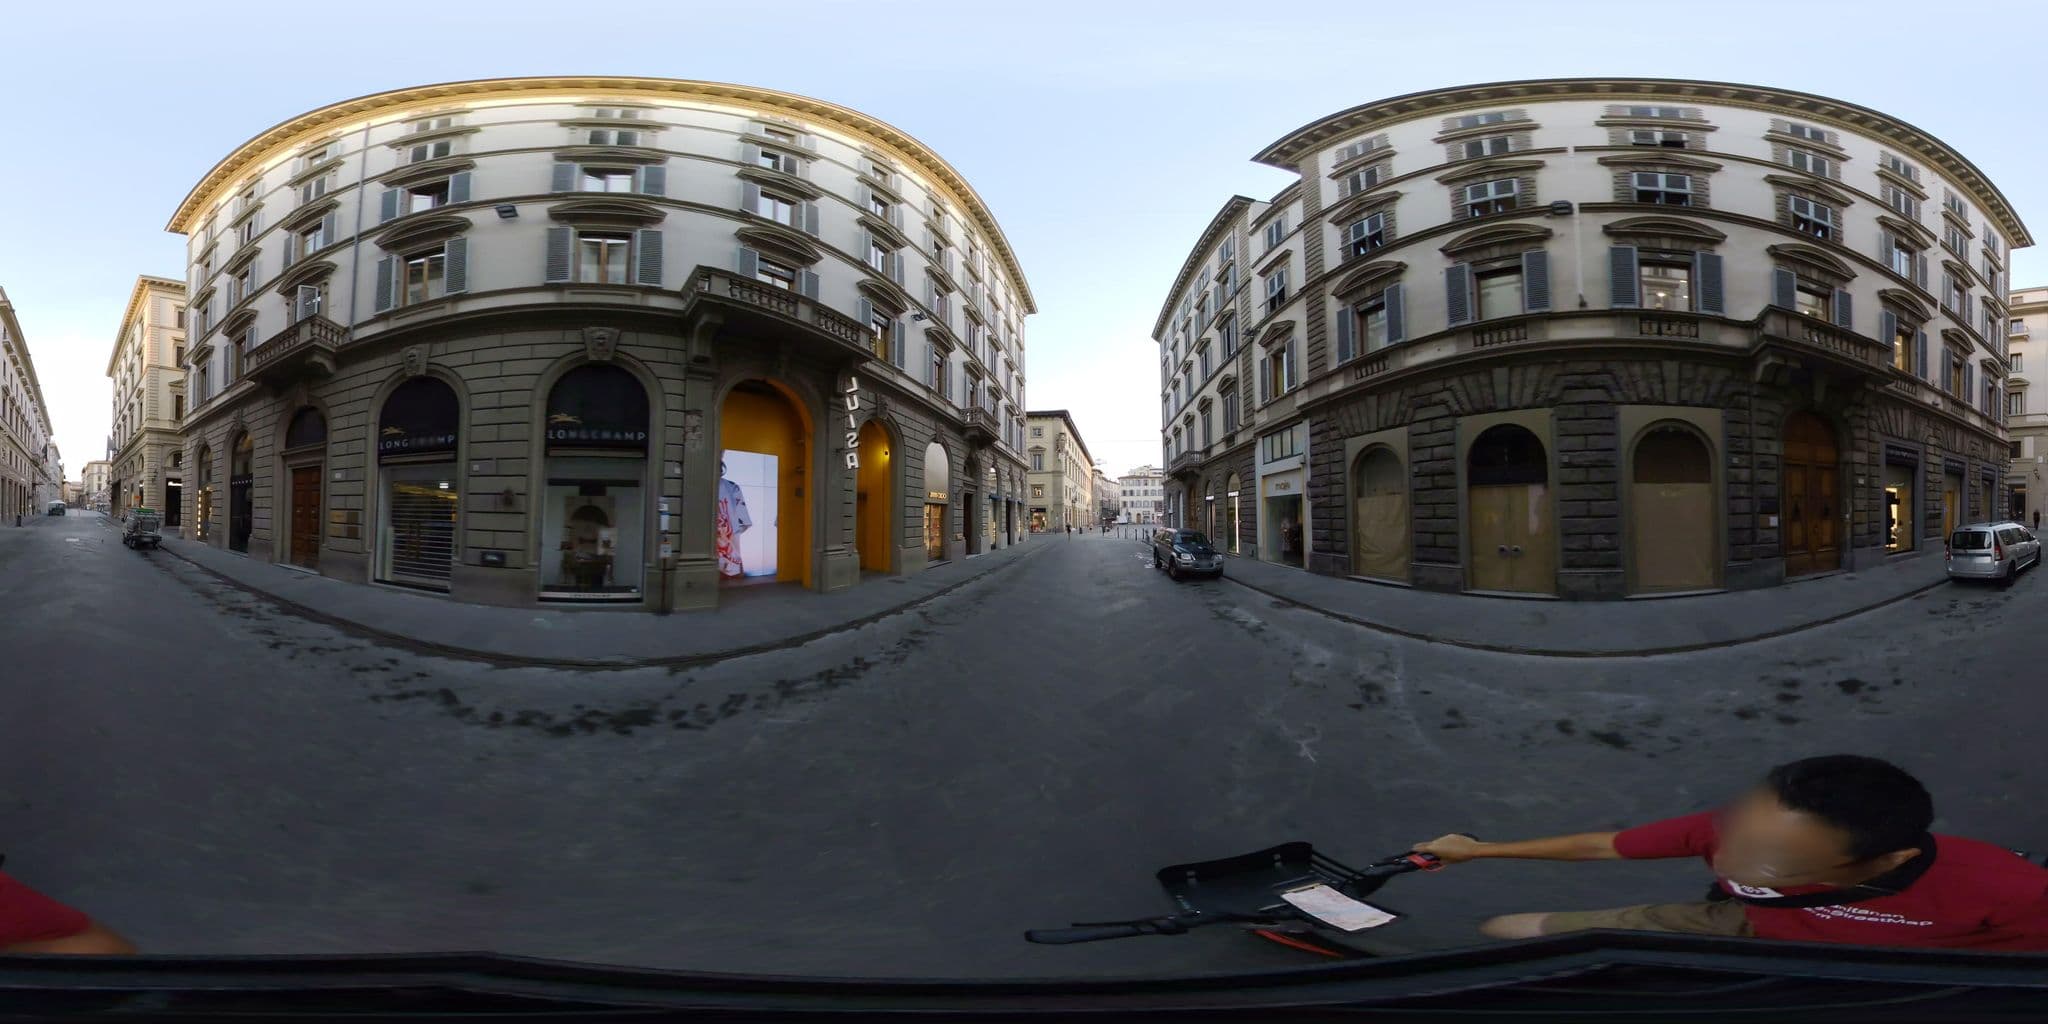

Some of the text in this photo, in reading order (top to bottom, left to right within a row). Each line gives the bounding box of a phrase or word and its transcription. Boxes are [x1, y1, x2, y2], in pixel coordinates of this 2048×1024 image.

[380, 434, 455, 450] LONGMP
[548, 429, 646, 441] LONGCHAMP
[1814, 906, 1933, 926] enStreetMap
